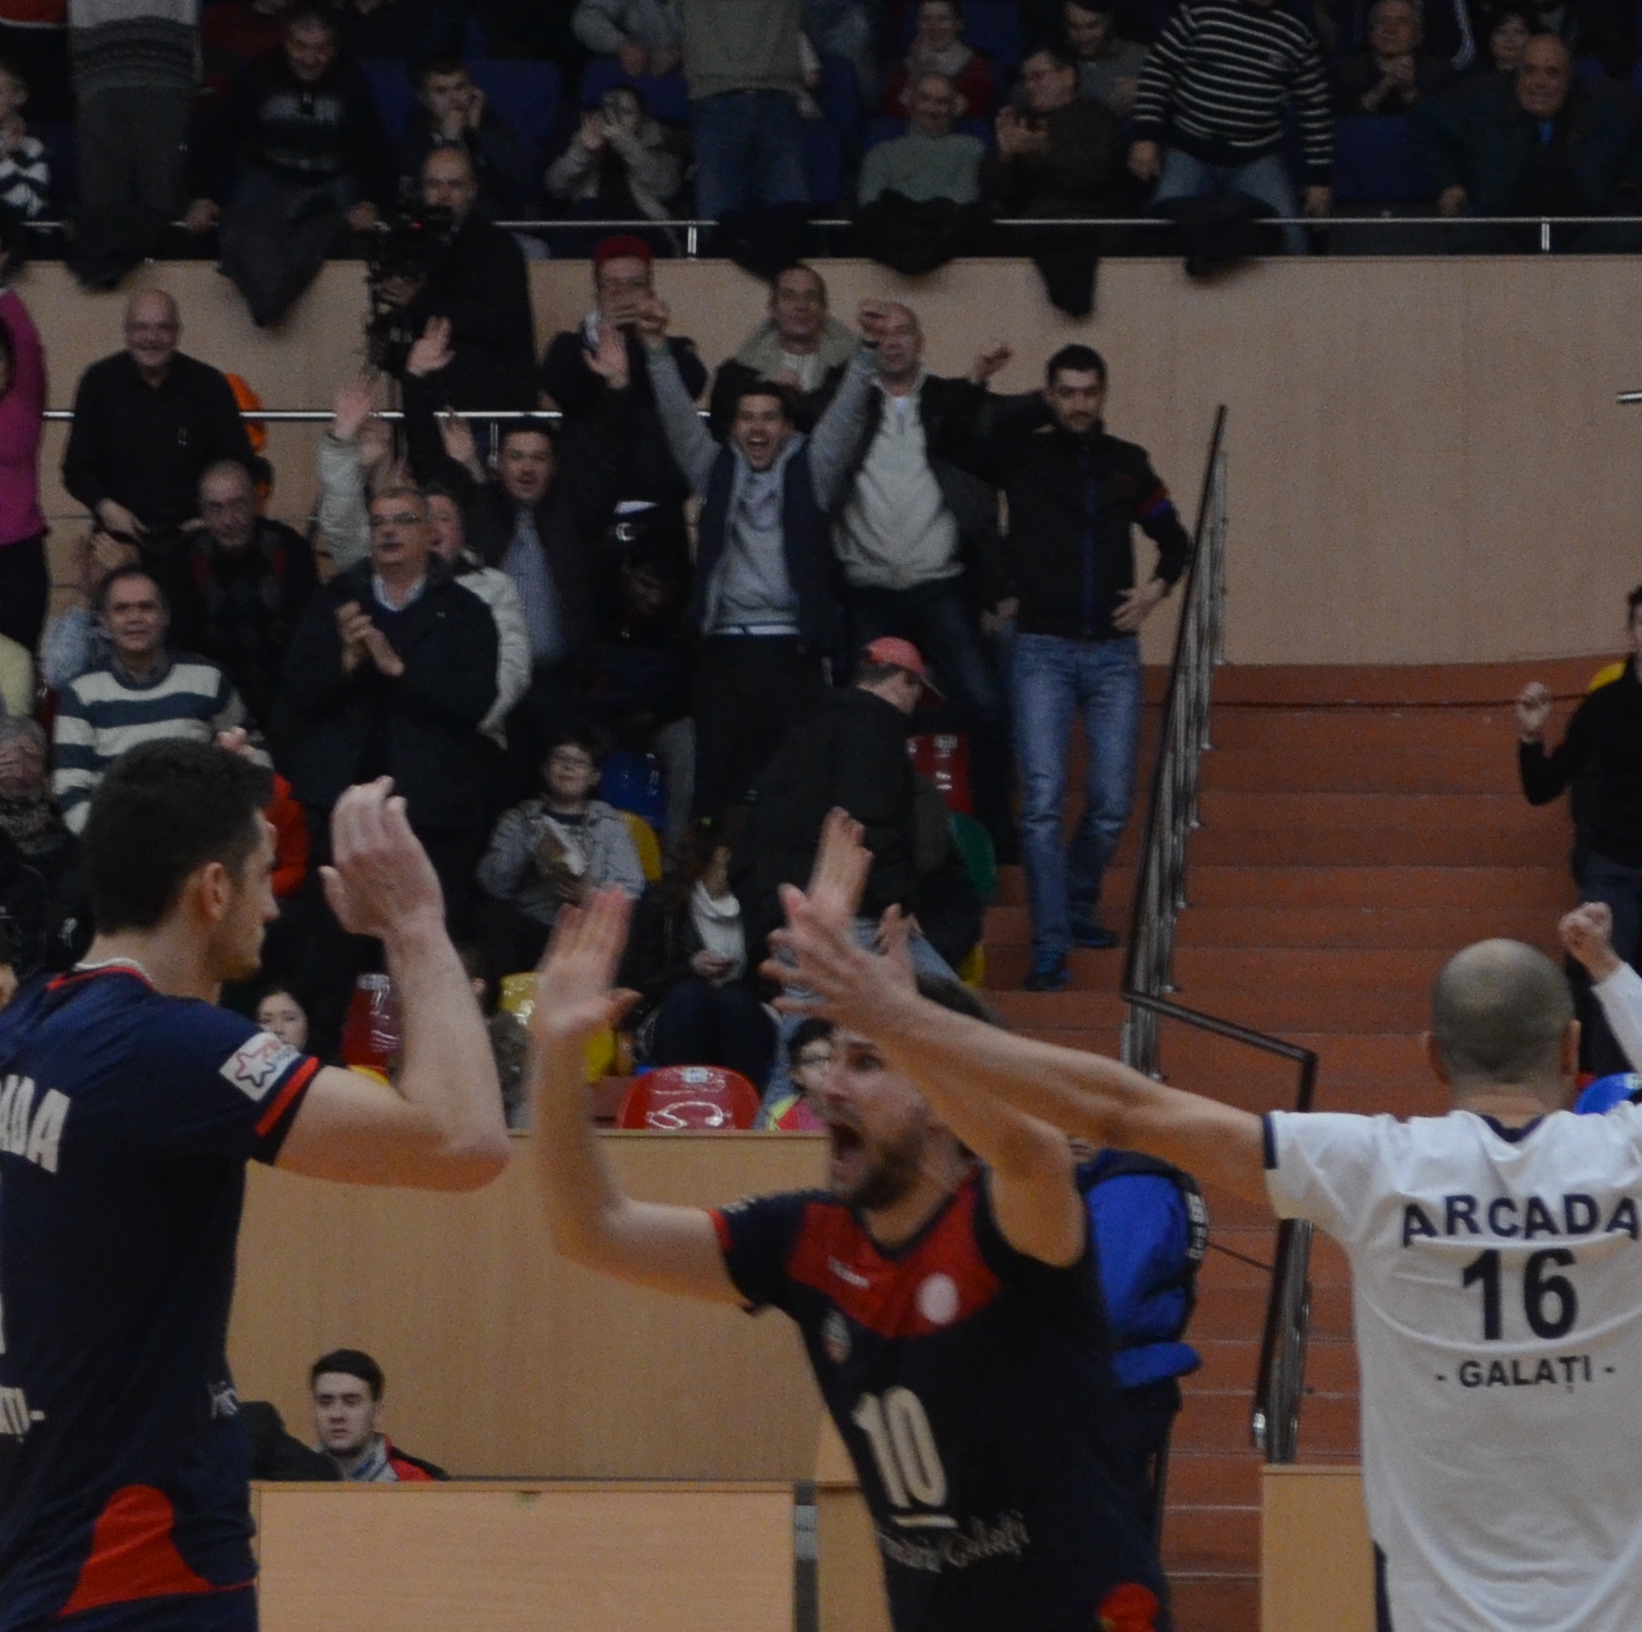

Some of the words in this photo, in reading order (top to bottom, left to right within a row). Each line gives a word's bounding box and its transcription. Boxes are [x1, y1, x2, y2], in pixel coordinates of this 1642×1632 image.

[1403, 1193, 1640, 1248] ARCADA
[1463, 1248, 1577, 1340] 16
[850, 1385, 948, 1509] 10
